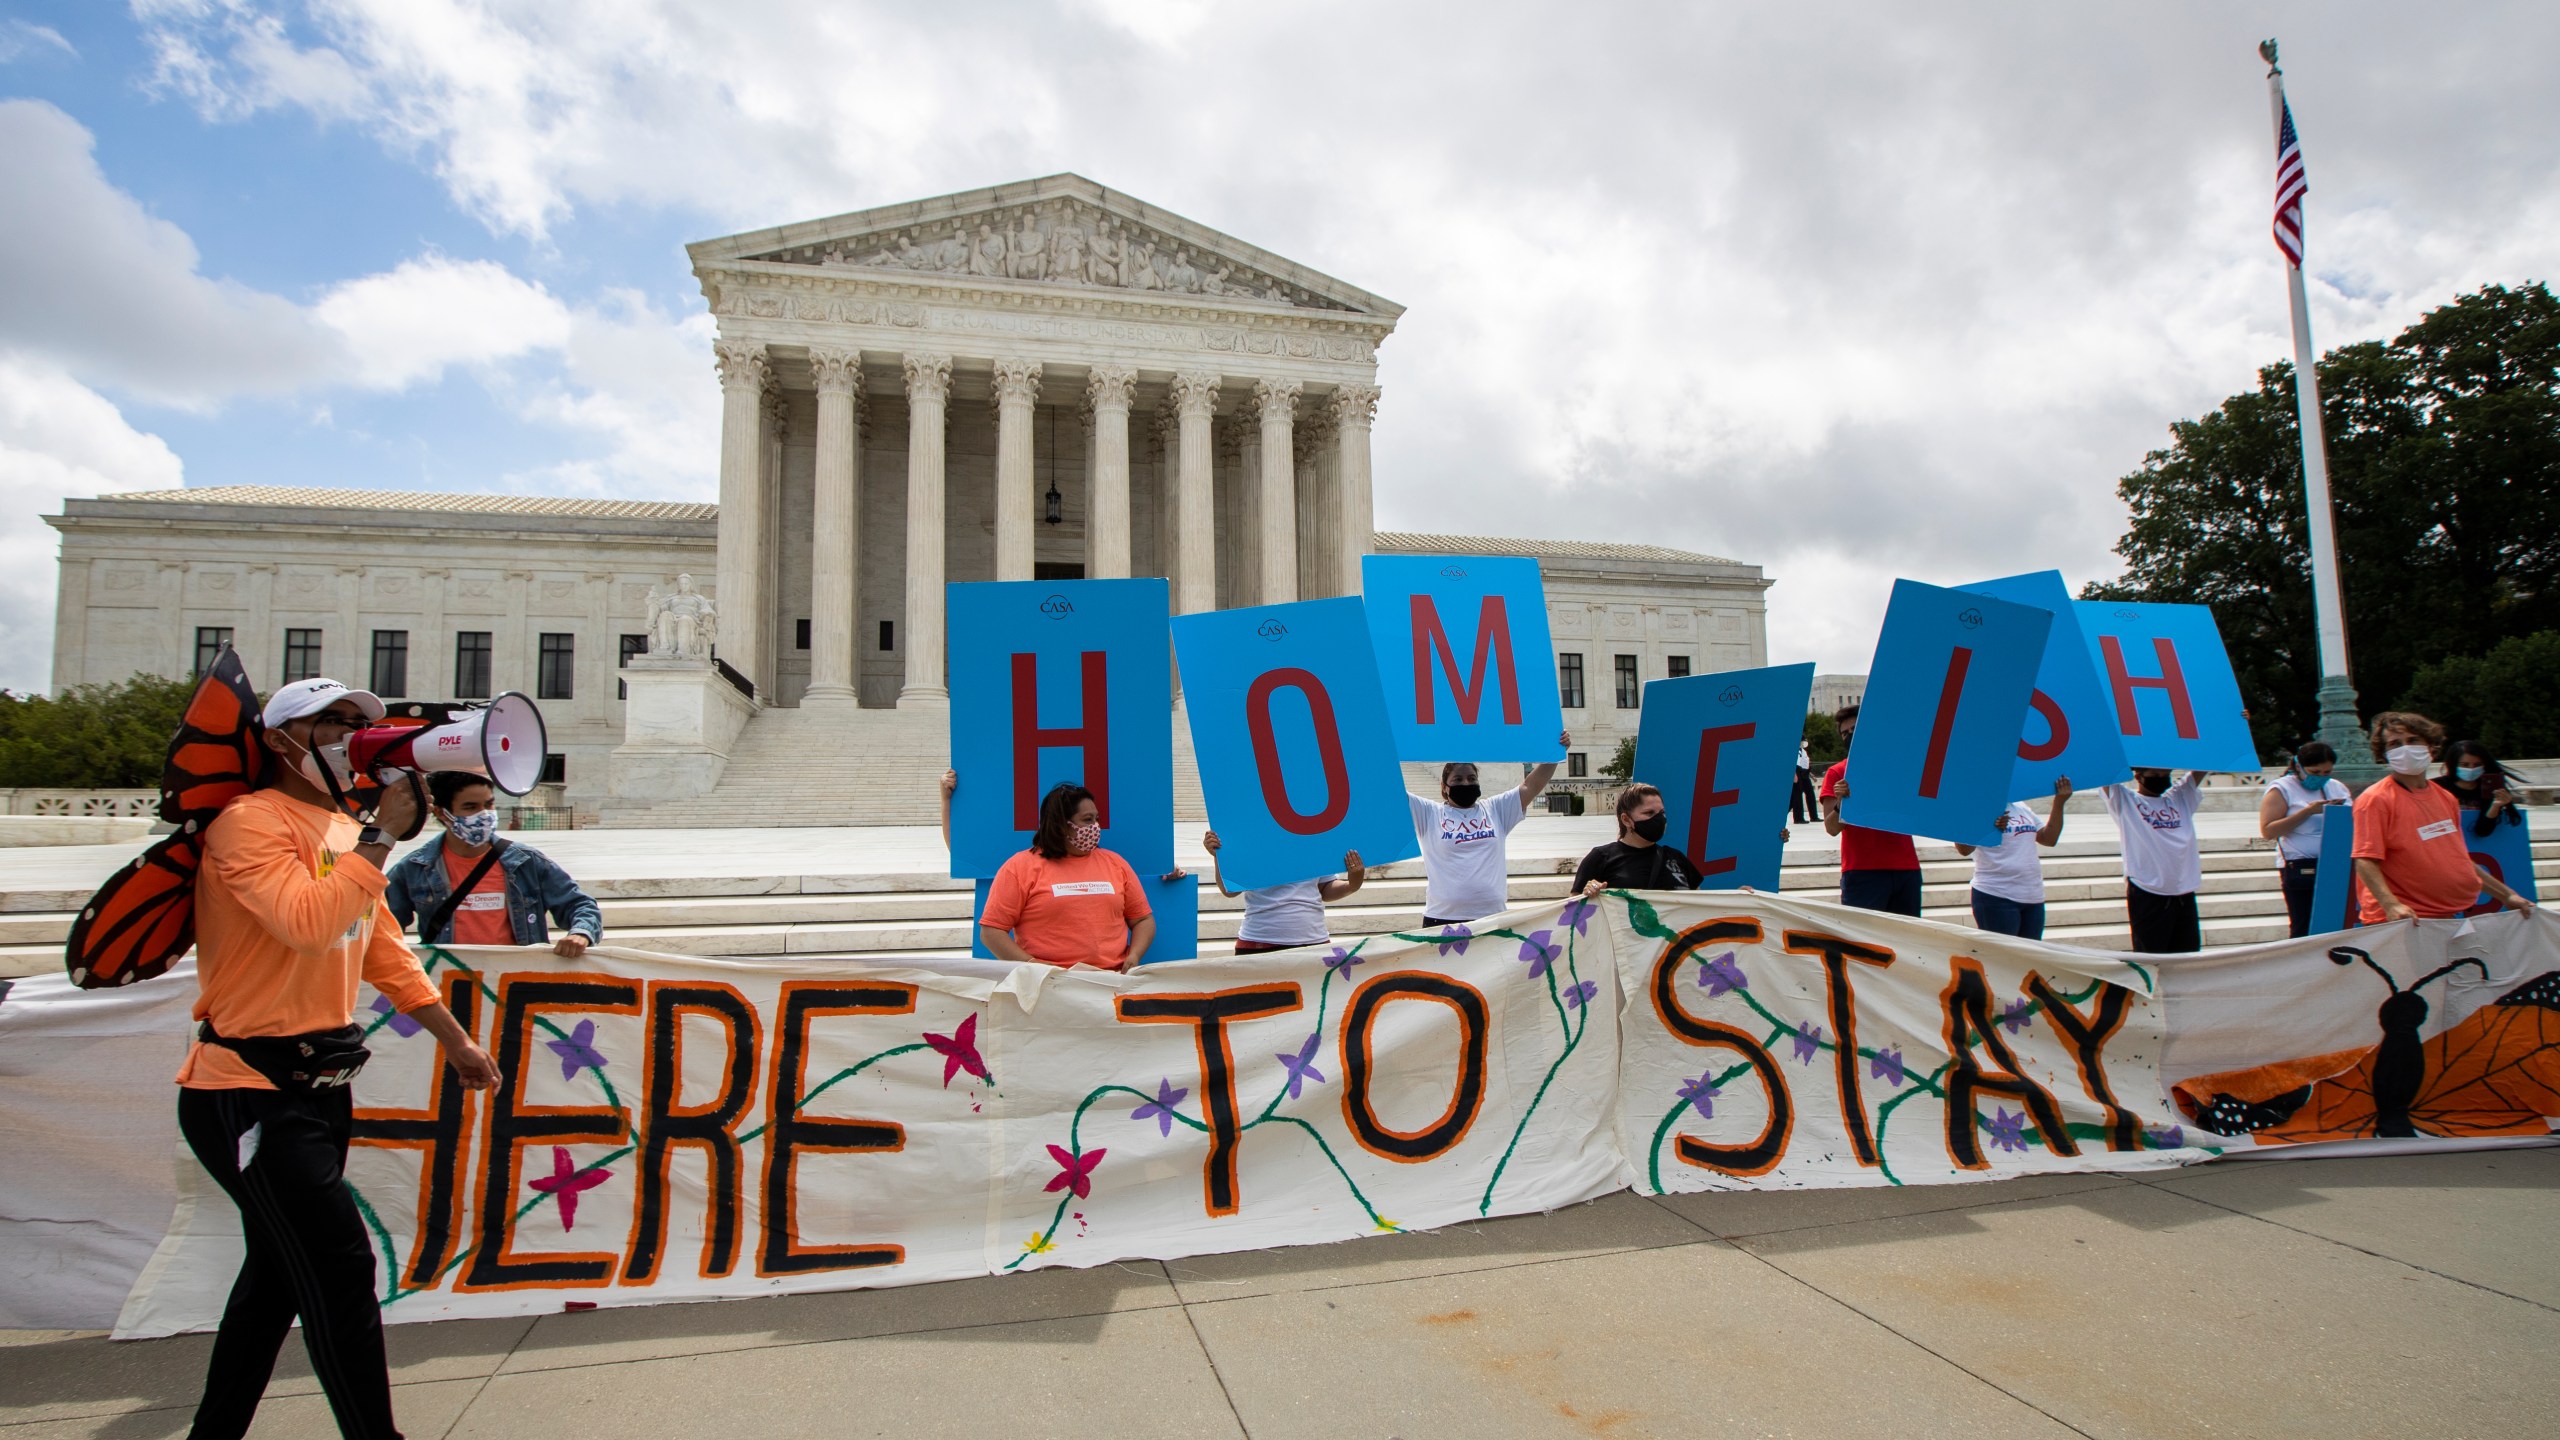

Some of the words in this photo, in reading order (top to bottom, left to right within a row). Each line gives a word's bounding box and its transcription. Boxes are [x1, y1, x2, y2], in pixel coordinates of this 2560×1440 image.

[941, 313, 1003, 330] EQUAL
[1010, 319, 1079, 335] JUSTICE
[1088, 324, 1144, 340] UNDER
[1154, 330, 1187, 343] LAW
[1439, 569, 1468, 577] CASA
[1040, 601, 1075, 613] CASA
[1958, 611, 1984, 626] CASA
[1257, 624, 1289, 637] CASA
[1411, 595, 1522, 724] M
[1718, 690, 1744, 702] CASA
[2099, 636, 2199, 739] H
[1919, 647, 1972, 798] I
[439, 736, 462, 746] PYLE
[1011, 651, 1110, 832] H
[1246, 668, 1350, 835] O
[1687, 722, 1756, 877] E
[2137, 803, 2180, 821] CASA
[1442, 818, 1492, 833] CASA
[1441, 832, 1453, 840] IN
[1455, 829, 1496, 841] ACTION
[472, 901, 500, 909] ACTION
[312, 1065, 362, 1088] FILA
[350, 970, 919, 1293] HERE
[1114, 970, 1490, 1218] TO
[1650, 916, 2144, 1177] STAY
